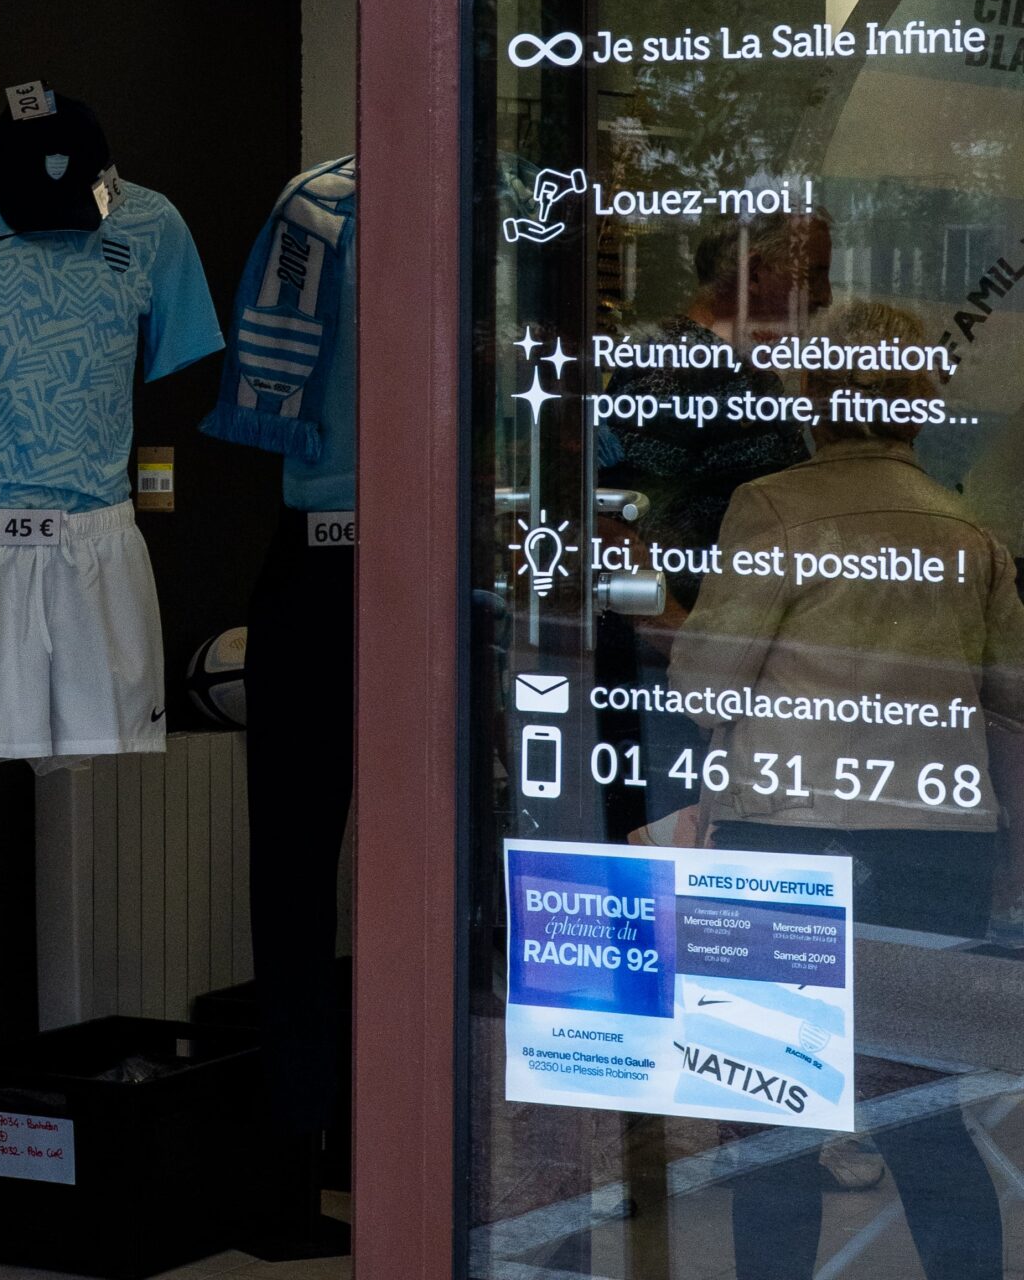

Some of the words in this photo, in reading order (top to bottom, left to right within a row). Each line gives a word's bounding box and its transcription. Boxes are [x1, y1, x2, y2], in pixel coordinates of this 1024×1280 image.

[593, 31, 633, 64] Je
[643, 29, 710, 62] suis
[721, 27, 761, 59] La
[772, 24, 855, 59] Salle
[866, 20, 986, 56] Infinie
[19, 96, 39, 113] 20
[593, 181, 791, 216] Louez-moi
[804, 181, 813, 214] !
[277, 232, 310, 291] 2012
[592, 334, 741, 374] Réunion,
[751, 334, 958, 376] célébration,
[591, 392, 718, 428] pop-up
[726, 392, 820, 428] store,
[831, 390, 978, 426] fitness...
[4, 518, 33, 538] 45
[39, 518, 54, 537] €
[591, 538, 640, 575] Ici,
[650, 543, 723, 574] tout
[732, 547, 784, 577] est
[794, 548, 944, 585] possible
[957, 549, 966, 583] !
[590, 685, 976, 729] contact@lacanotiere.fr
[591, 743, 647, 788] 01
[668, 748, 730, 791] 46
[752, 752, 810, 797] 31
[834, 757, 895, 802] 57
[917, 763, 982, 808] 68
[688, 874, 733, 890] DATES
[736, 876, 834, 897] D'OUVERTURE
[526, 889, 656, 921] BOUTIQUE
[545, 914, 615, 941] éphémère
[617, 924, 637, 942] du
[684, 915, 722, 929] Mercredi
[723, 917, 751, 930] 03/09
[773, 921, 811, 934] Mercredi
[811, 924, 837, 936] 17/09
[523, 939, 622, 970] RACING
[626, 949, 659, 973] 92
[687, 942, 719, 955] Samedi
[720, 945, 749, 958] 06/09
[773, 949, 806, 963] Samedi
[807, 952, 836, 965] 20/09
[552, 1027, 565, 1038] LA
[567, 1029, 624, 1043] CANOTIERE
[522, 1046, 535, 1058] 88
[536, 1050, 571, 1062] avenue
[572, 1050, 611, 1065] Charles
[612, 1053, 624, 1066] de
[624, 1055, 655, 1069] Gaulle
[528, 1060, 559, 1073] 92350
[560, 1062, 571, 1074] Le
[573, 1063, 605, 1077] Plessis
[605, 1067, 649, 1081] Robinson
[785, 1046, 812, 1066] RACING
[811, 1060, 823, 1070] 92
[681, 1046, 809, 1114] NATIXIS
